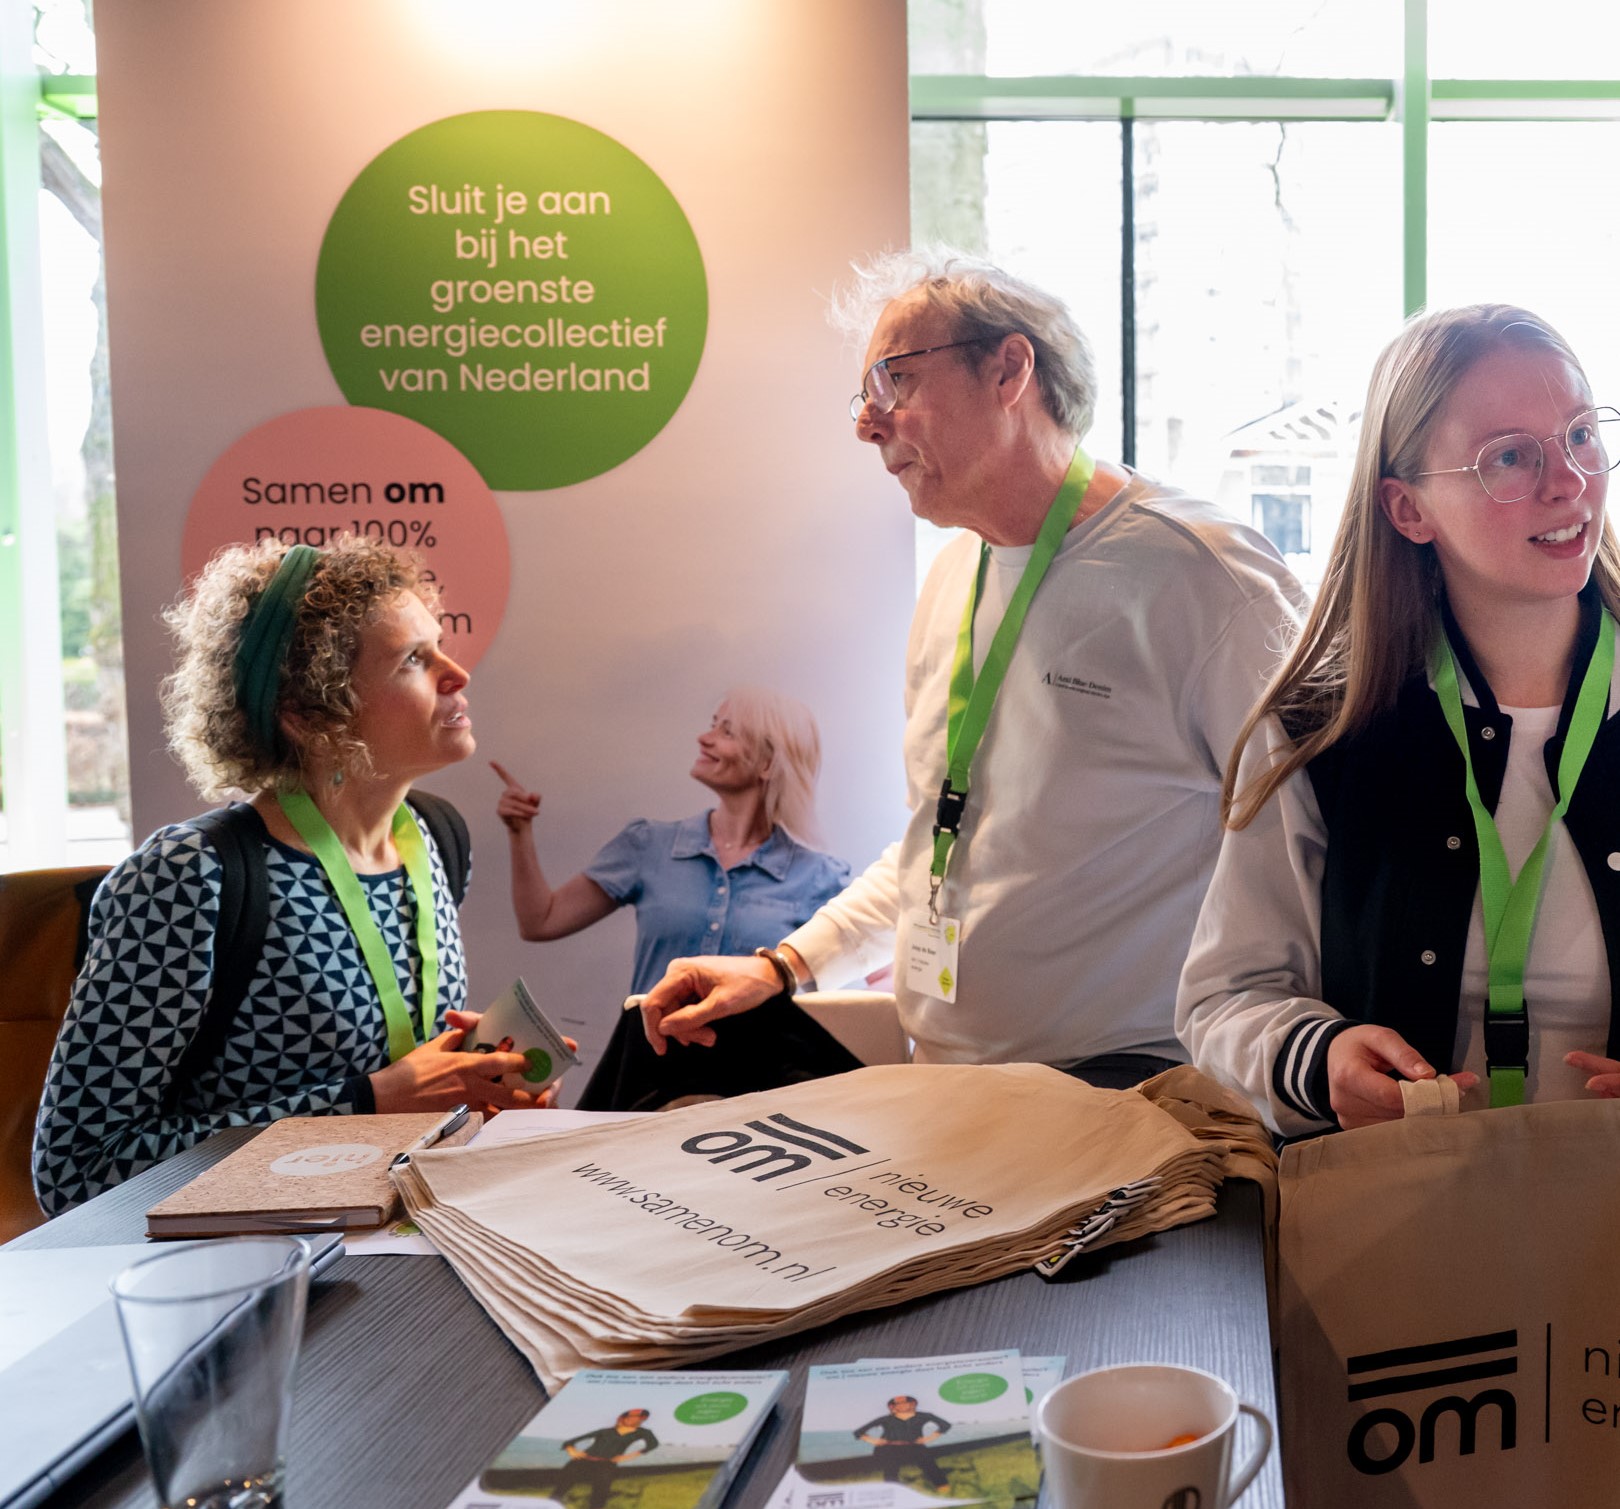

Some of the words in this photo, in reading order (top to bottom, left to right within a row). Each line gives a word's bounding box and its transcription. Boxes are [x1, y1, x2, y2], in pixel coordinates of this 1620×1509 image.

[408, 183, 487, 215] Sluit
[494, 183, 528, 224] je
[537, 191, 611, 216] aan
[455, 228, 498, 268] bij
[508, 228, 569, 260] het
[430, 275, 596, 312] groenste
[360, 317, 668, 357] energiecollectief
[379, 368, 448, 392] van
[459, 361, 650, 392] Nederland
[242, 476, 372, 505] Samen
[384, 481, 444, 505] om
[680, 1131, 813, 1182] om
[824, 1185, 946, 1237] energie
[869, 1170, 994, 1220] nieuwe
[571, 1162, 838, 1283] www.samenom.nl
[1347, 1388, 1517, 1476] om
